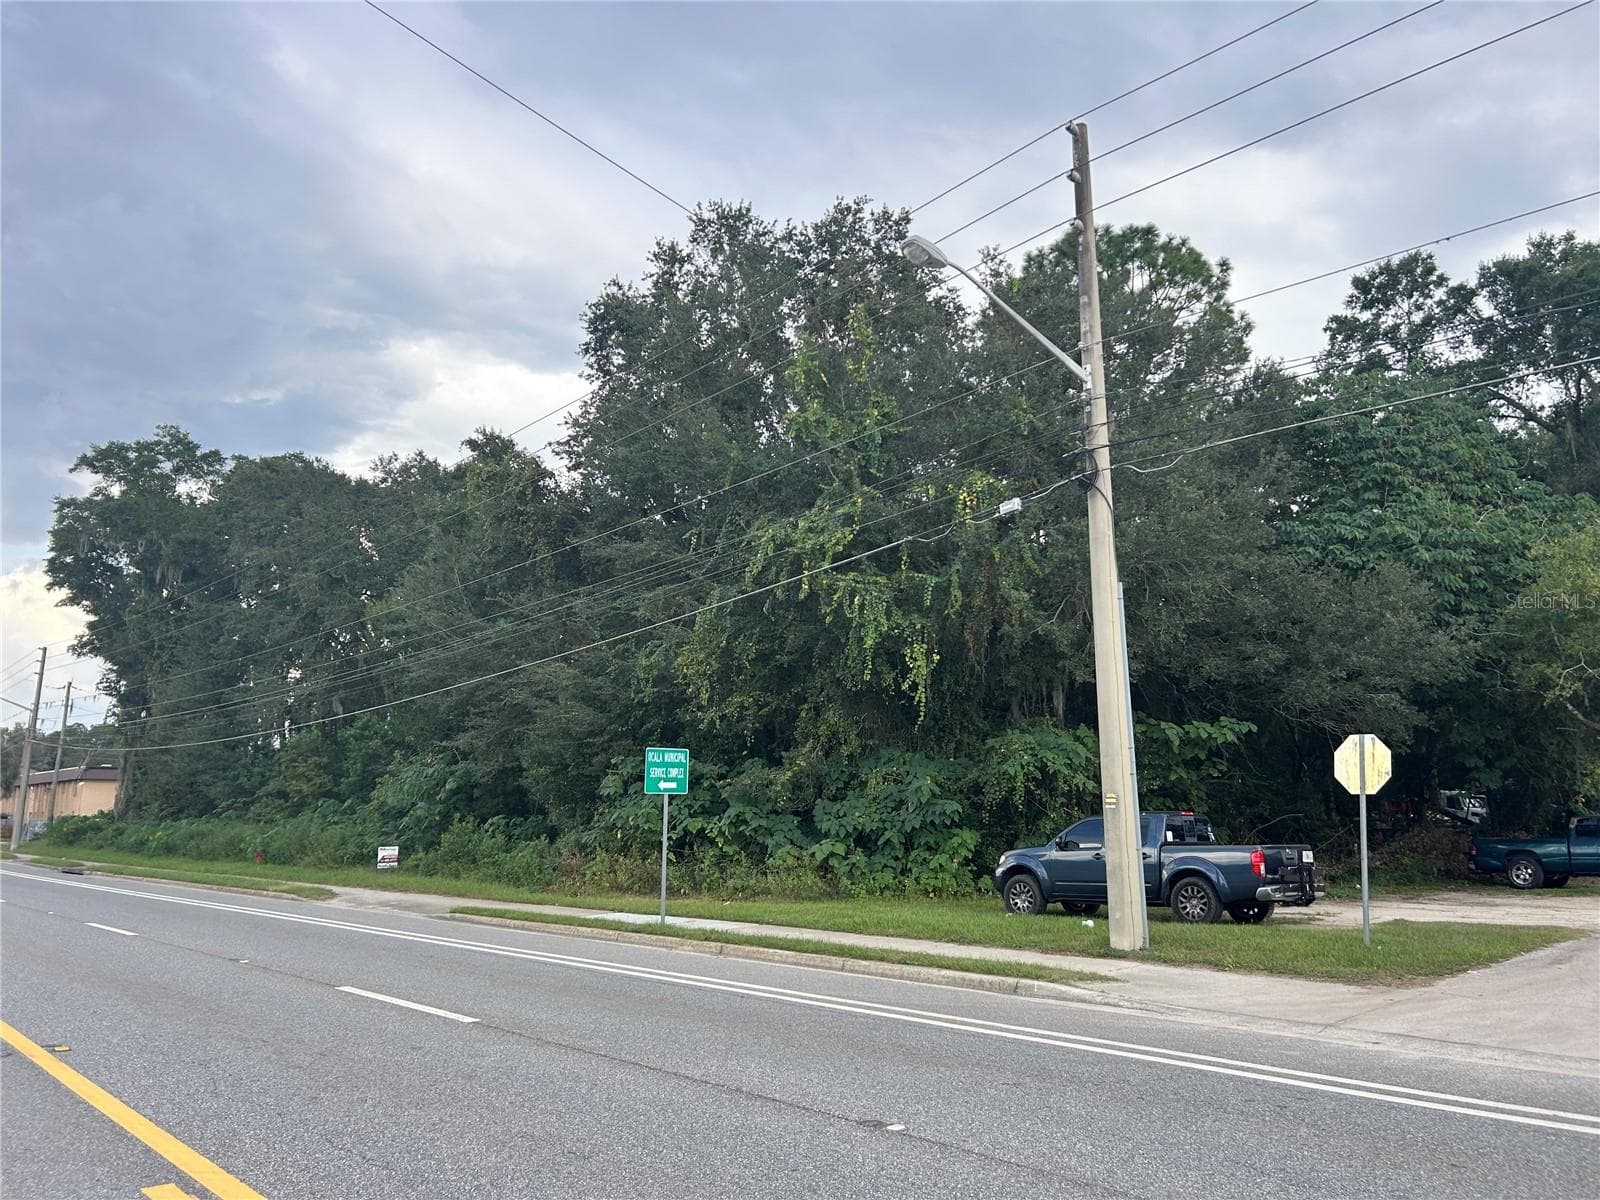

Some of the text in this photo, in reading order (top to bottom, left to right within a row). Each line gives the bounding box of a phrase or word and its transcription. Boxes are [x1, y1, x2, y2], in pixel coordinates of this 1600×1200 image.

[648, 751, 686, 763] OCALA MUNICIPAL
[649, 767, 684, 778] SERVICE COMPLEX
